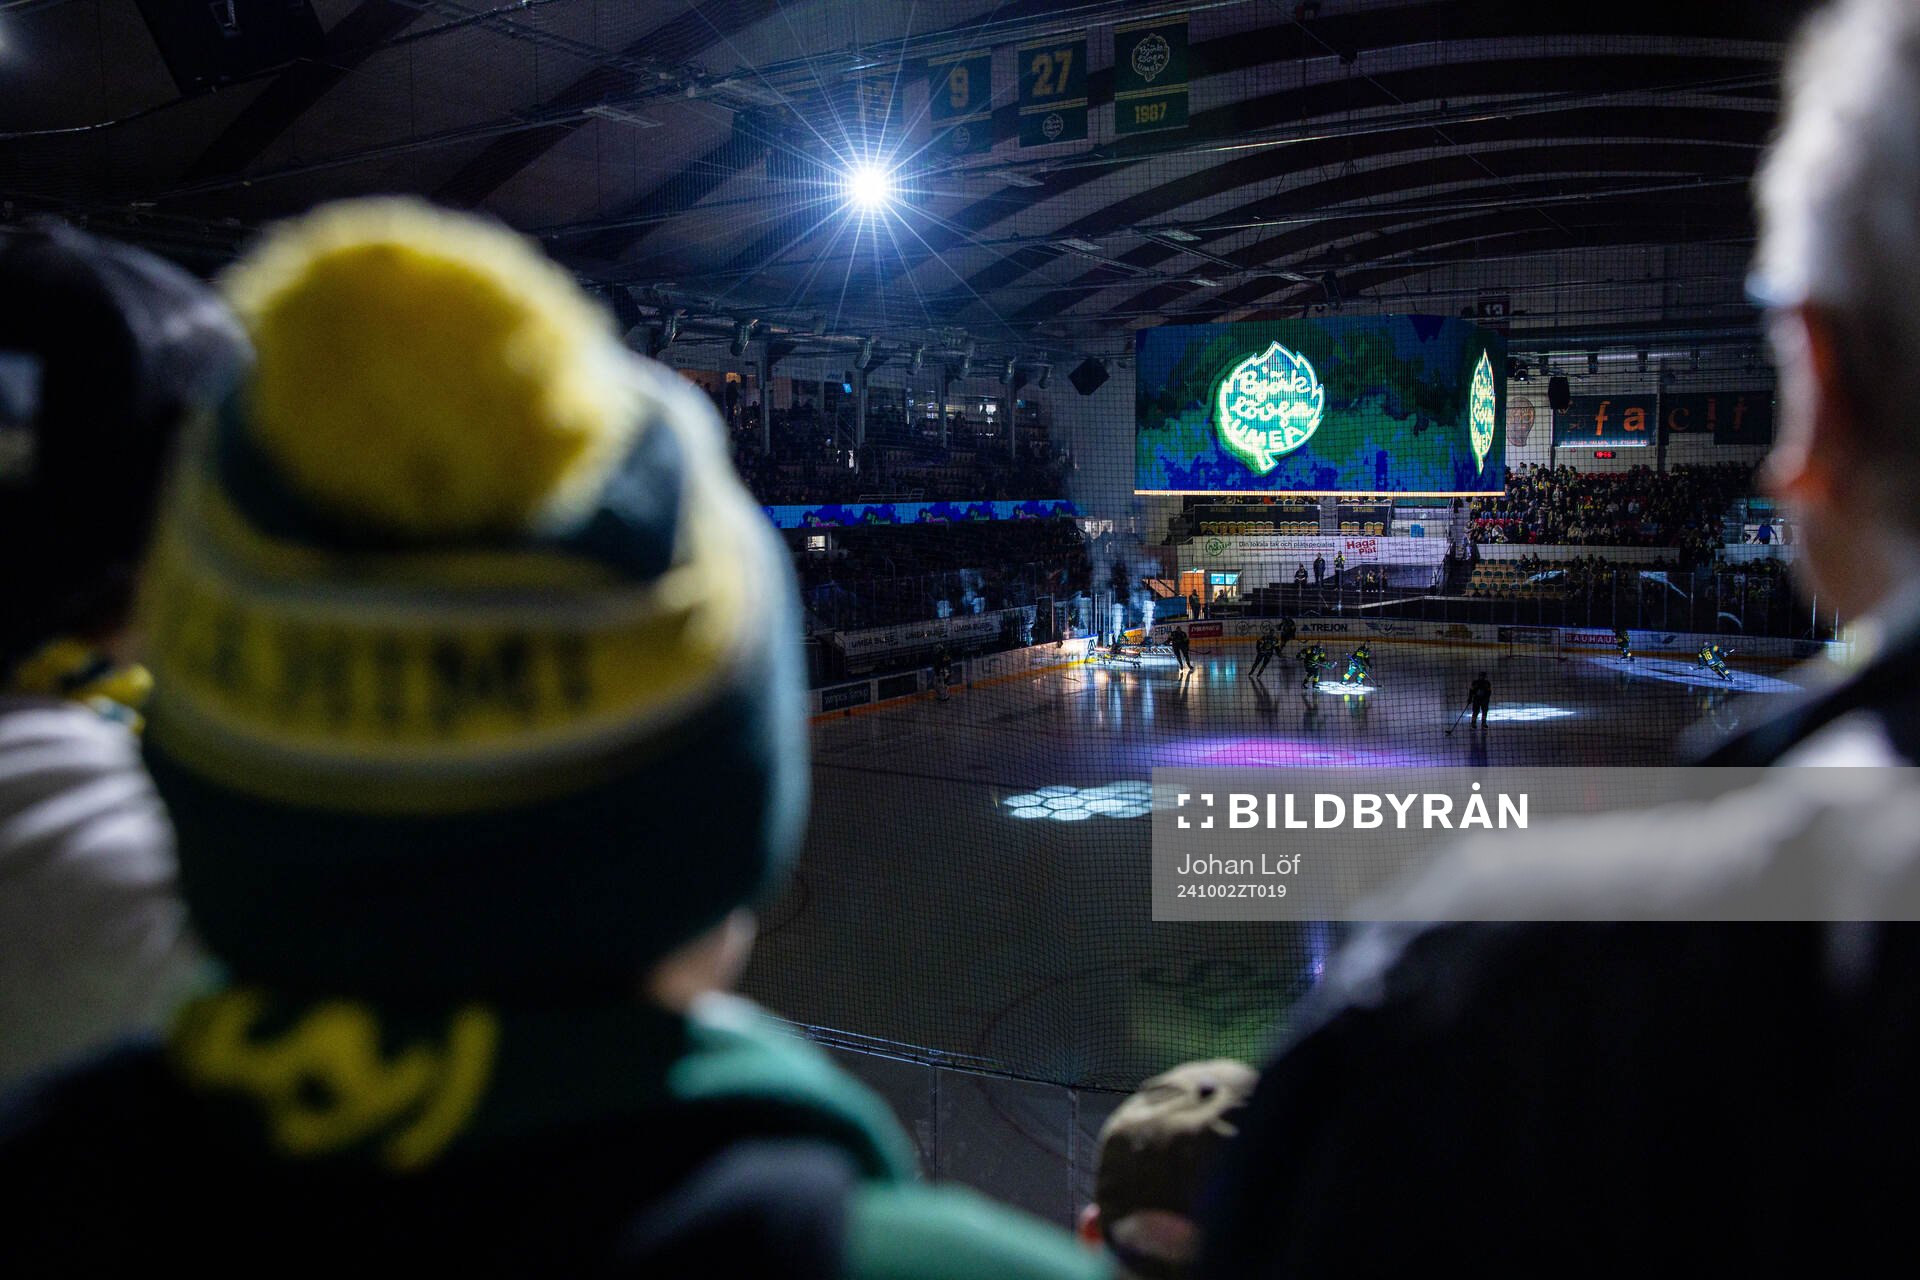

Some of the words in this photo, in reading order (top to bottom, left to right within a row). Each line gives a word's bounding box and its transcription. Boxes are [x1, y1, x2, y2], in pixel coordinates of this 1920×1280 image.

[1031, 48, 1073, 97] 27
[950, 65, 969, 109] 9
[1134, 102, 1168, 124] 1987
[1347, 539, 1376, 550] Haga
[1310, 623, 1348, 632] TREJON
